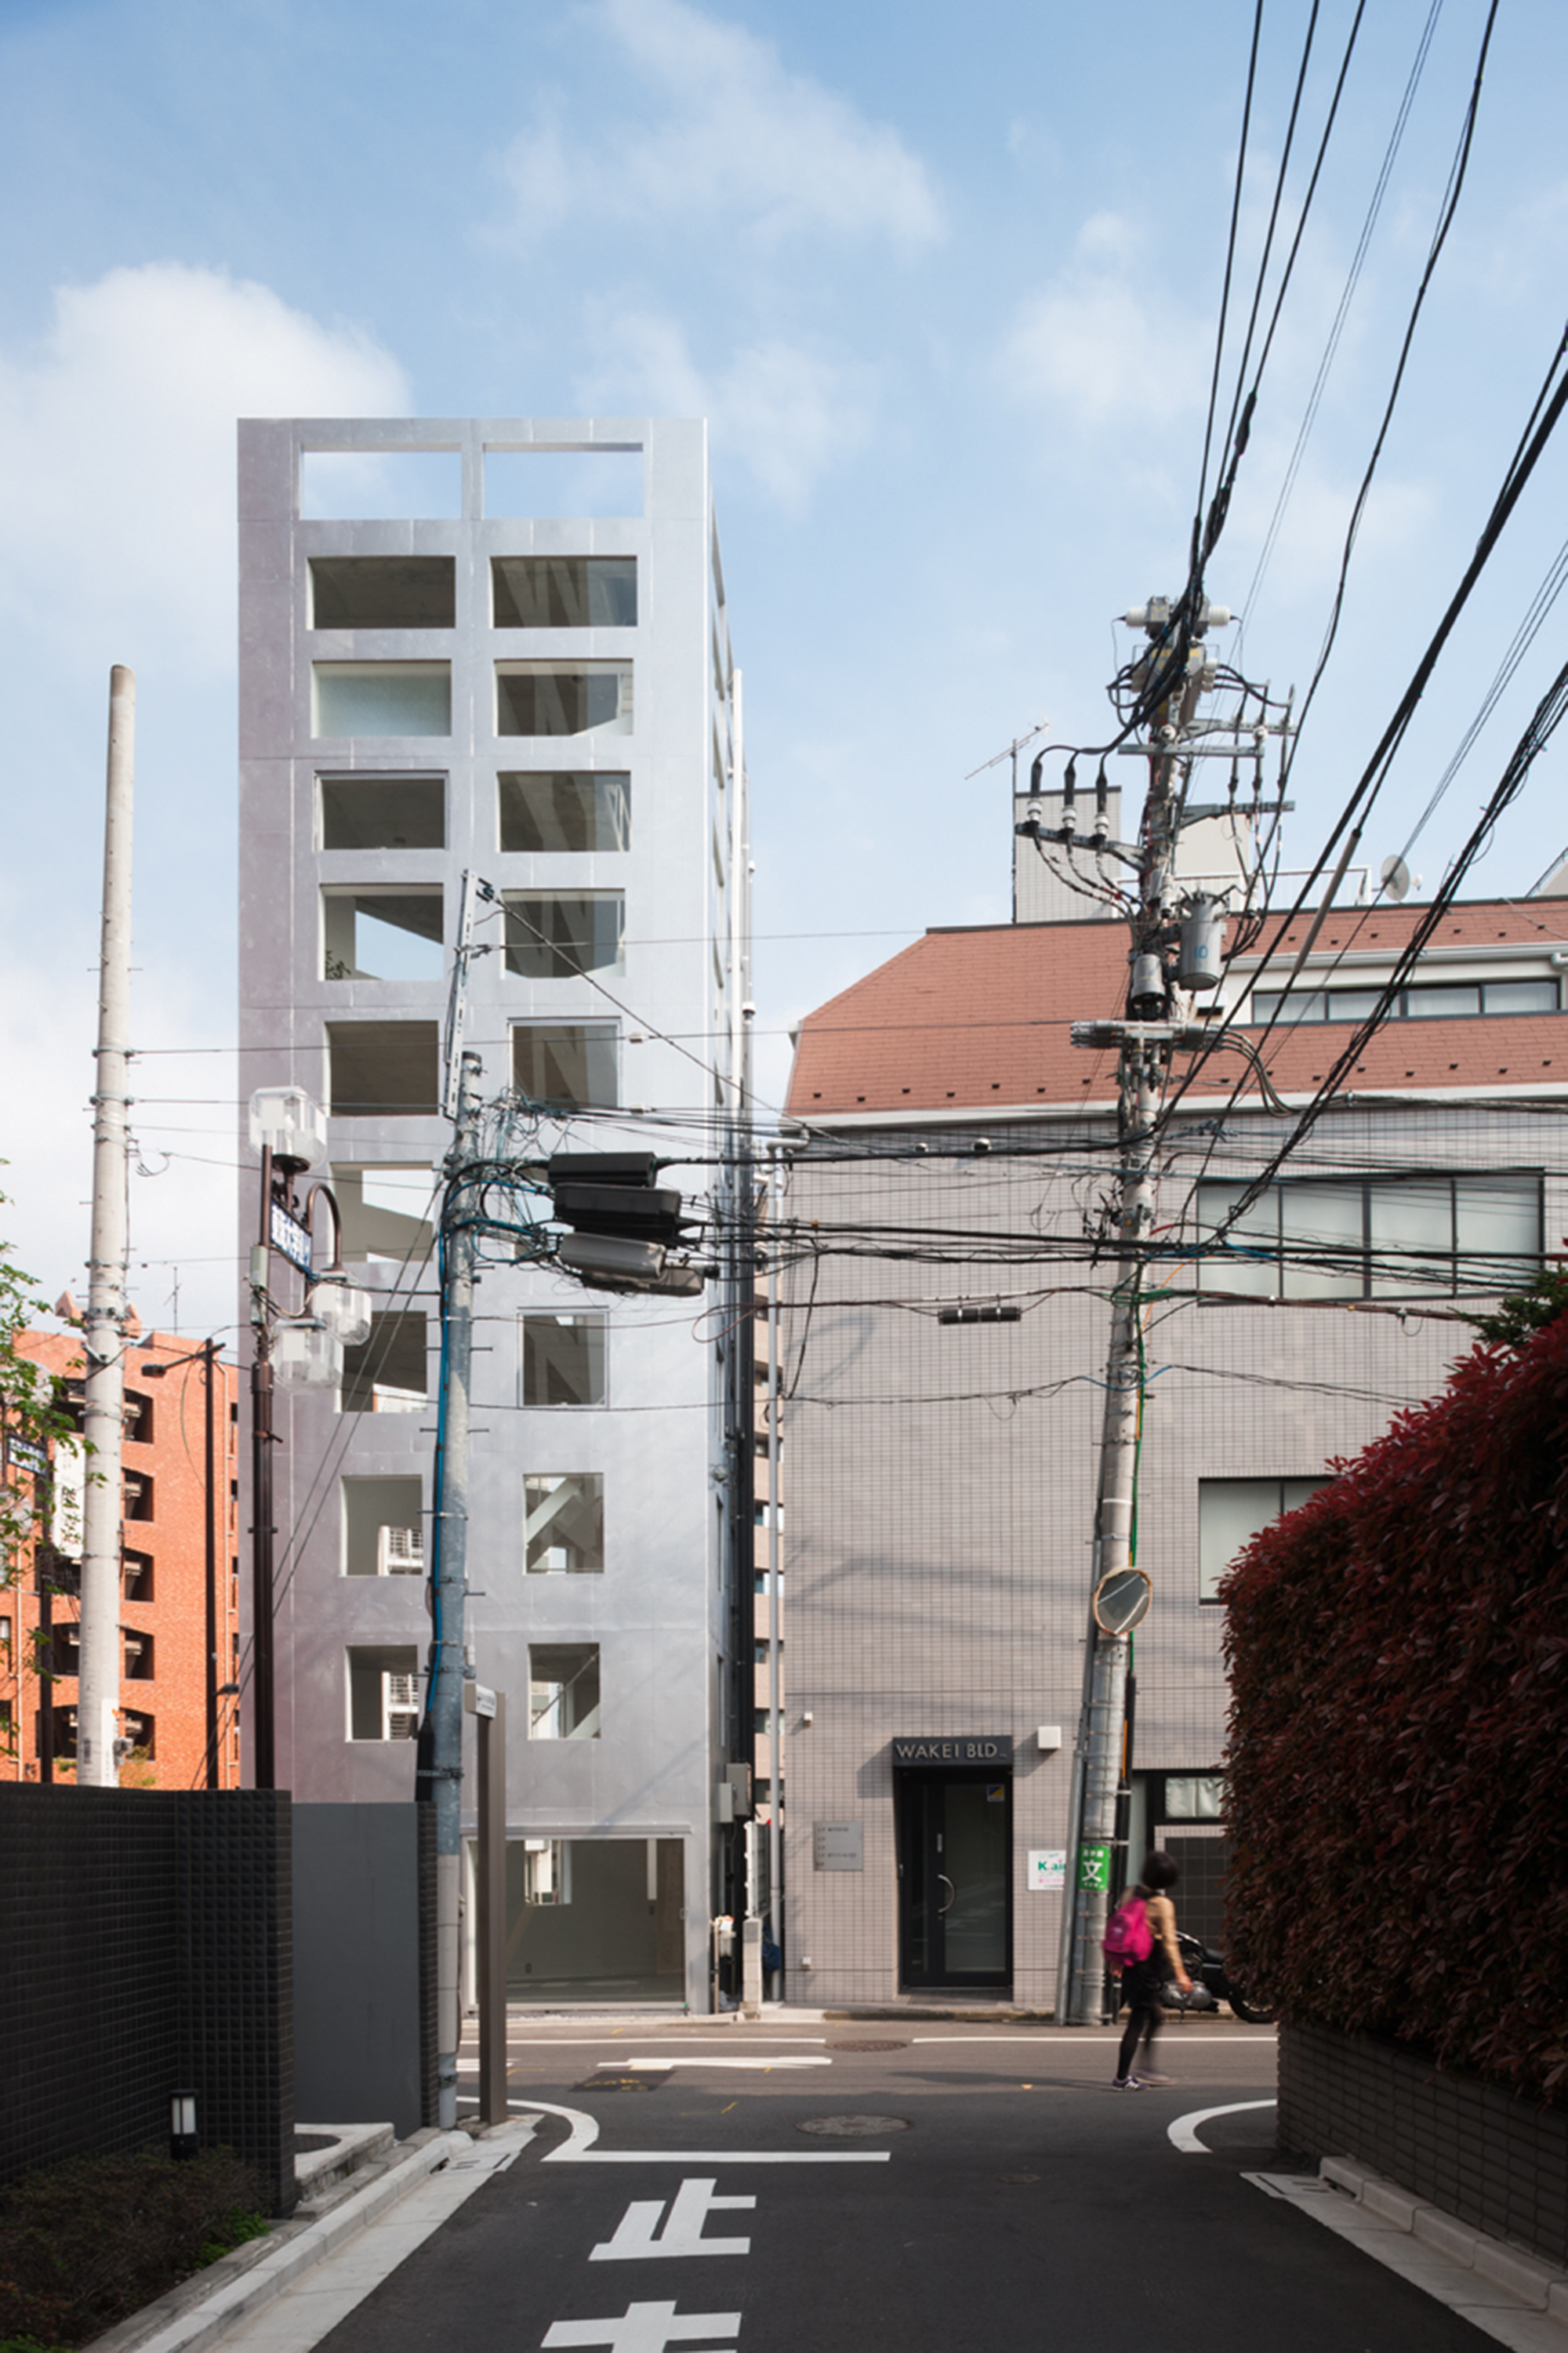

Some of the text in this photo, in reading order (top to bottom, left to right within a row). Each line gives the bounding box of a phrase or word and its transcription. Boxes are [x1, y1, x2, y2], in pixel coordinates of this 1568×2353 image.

[1194, 945, 1208, 959] 10
[896, 1743, 959, 1759] WAKEI
[1083, 1859, 1102, 1883] 文
